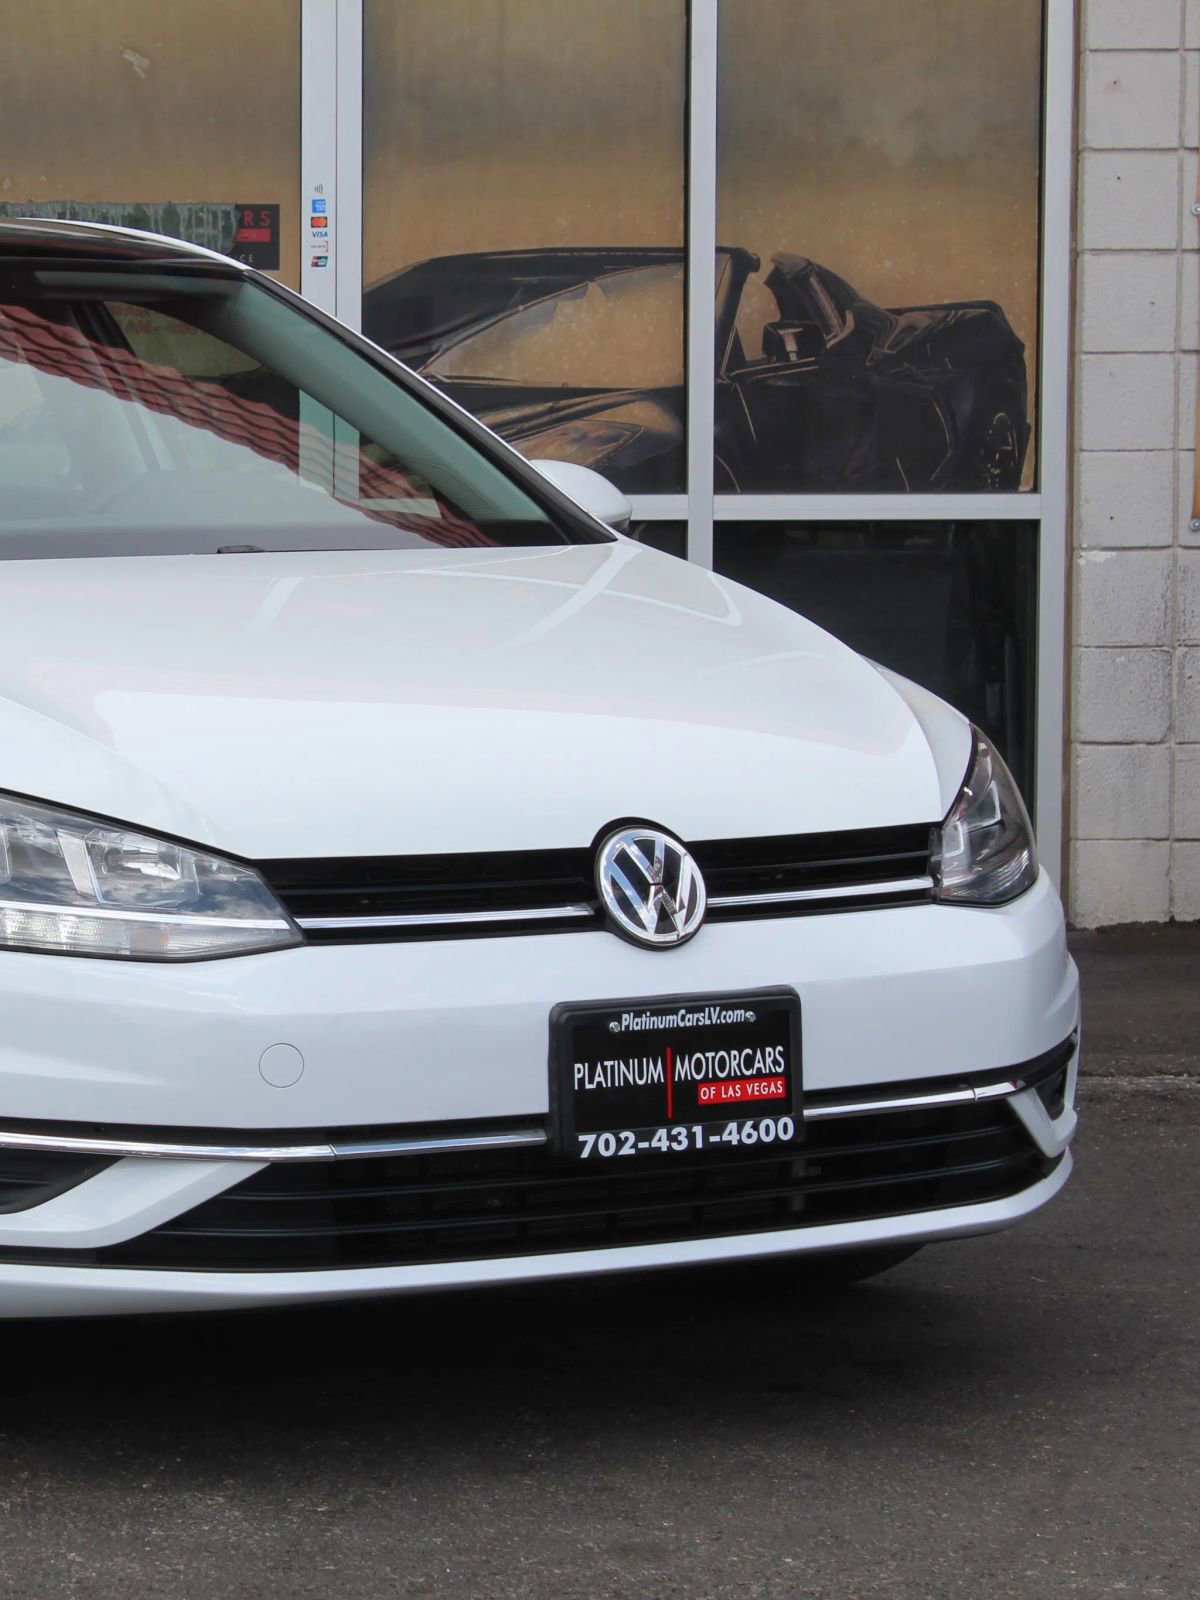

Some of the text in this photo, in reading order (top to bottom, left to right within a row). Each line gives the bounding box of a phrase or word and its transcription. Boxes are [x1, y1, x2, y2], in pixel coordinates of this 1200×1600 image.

[621, 1006, 745, 1032] PlatinumCarsLV.com
[574, 1045, 785, 1090] PLATINUM MOTORCARS
[700, 1080, 783, 1100] OF LAS VEGAS
[578, 1116, 795, 1159] 702-431-4600
